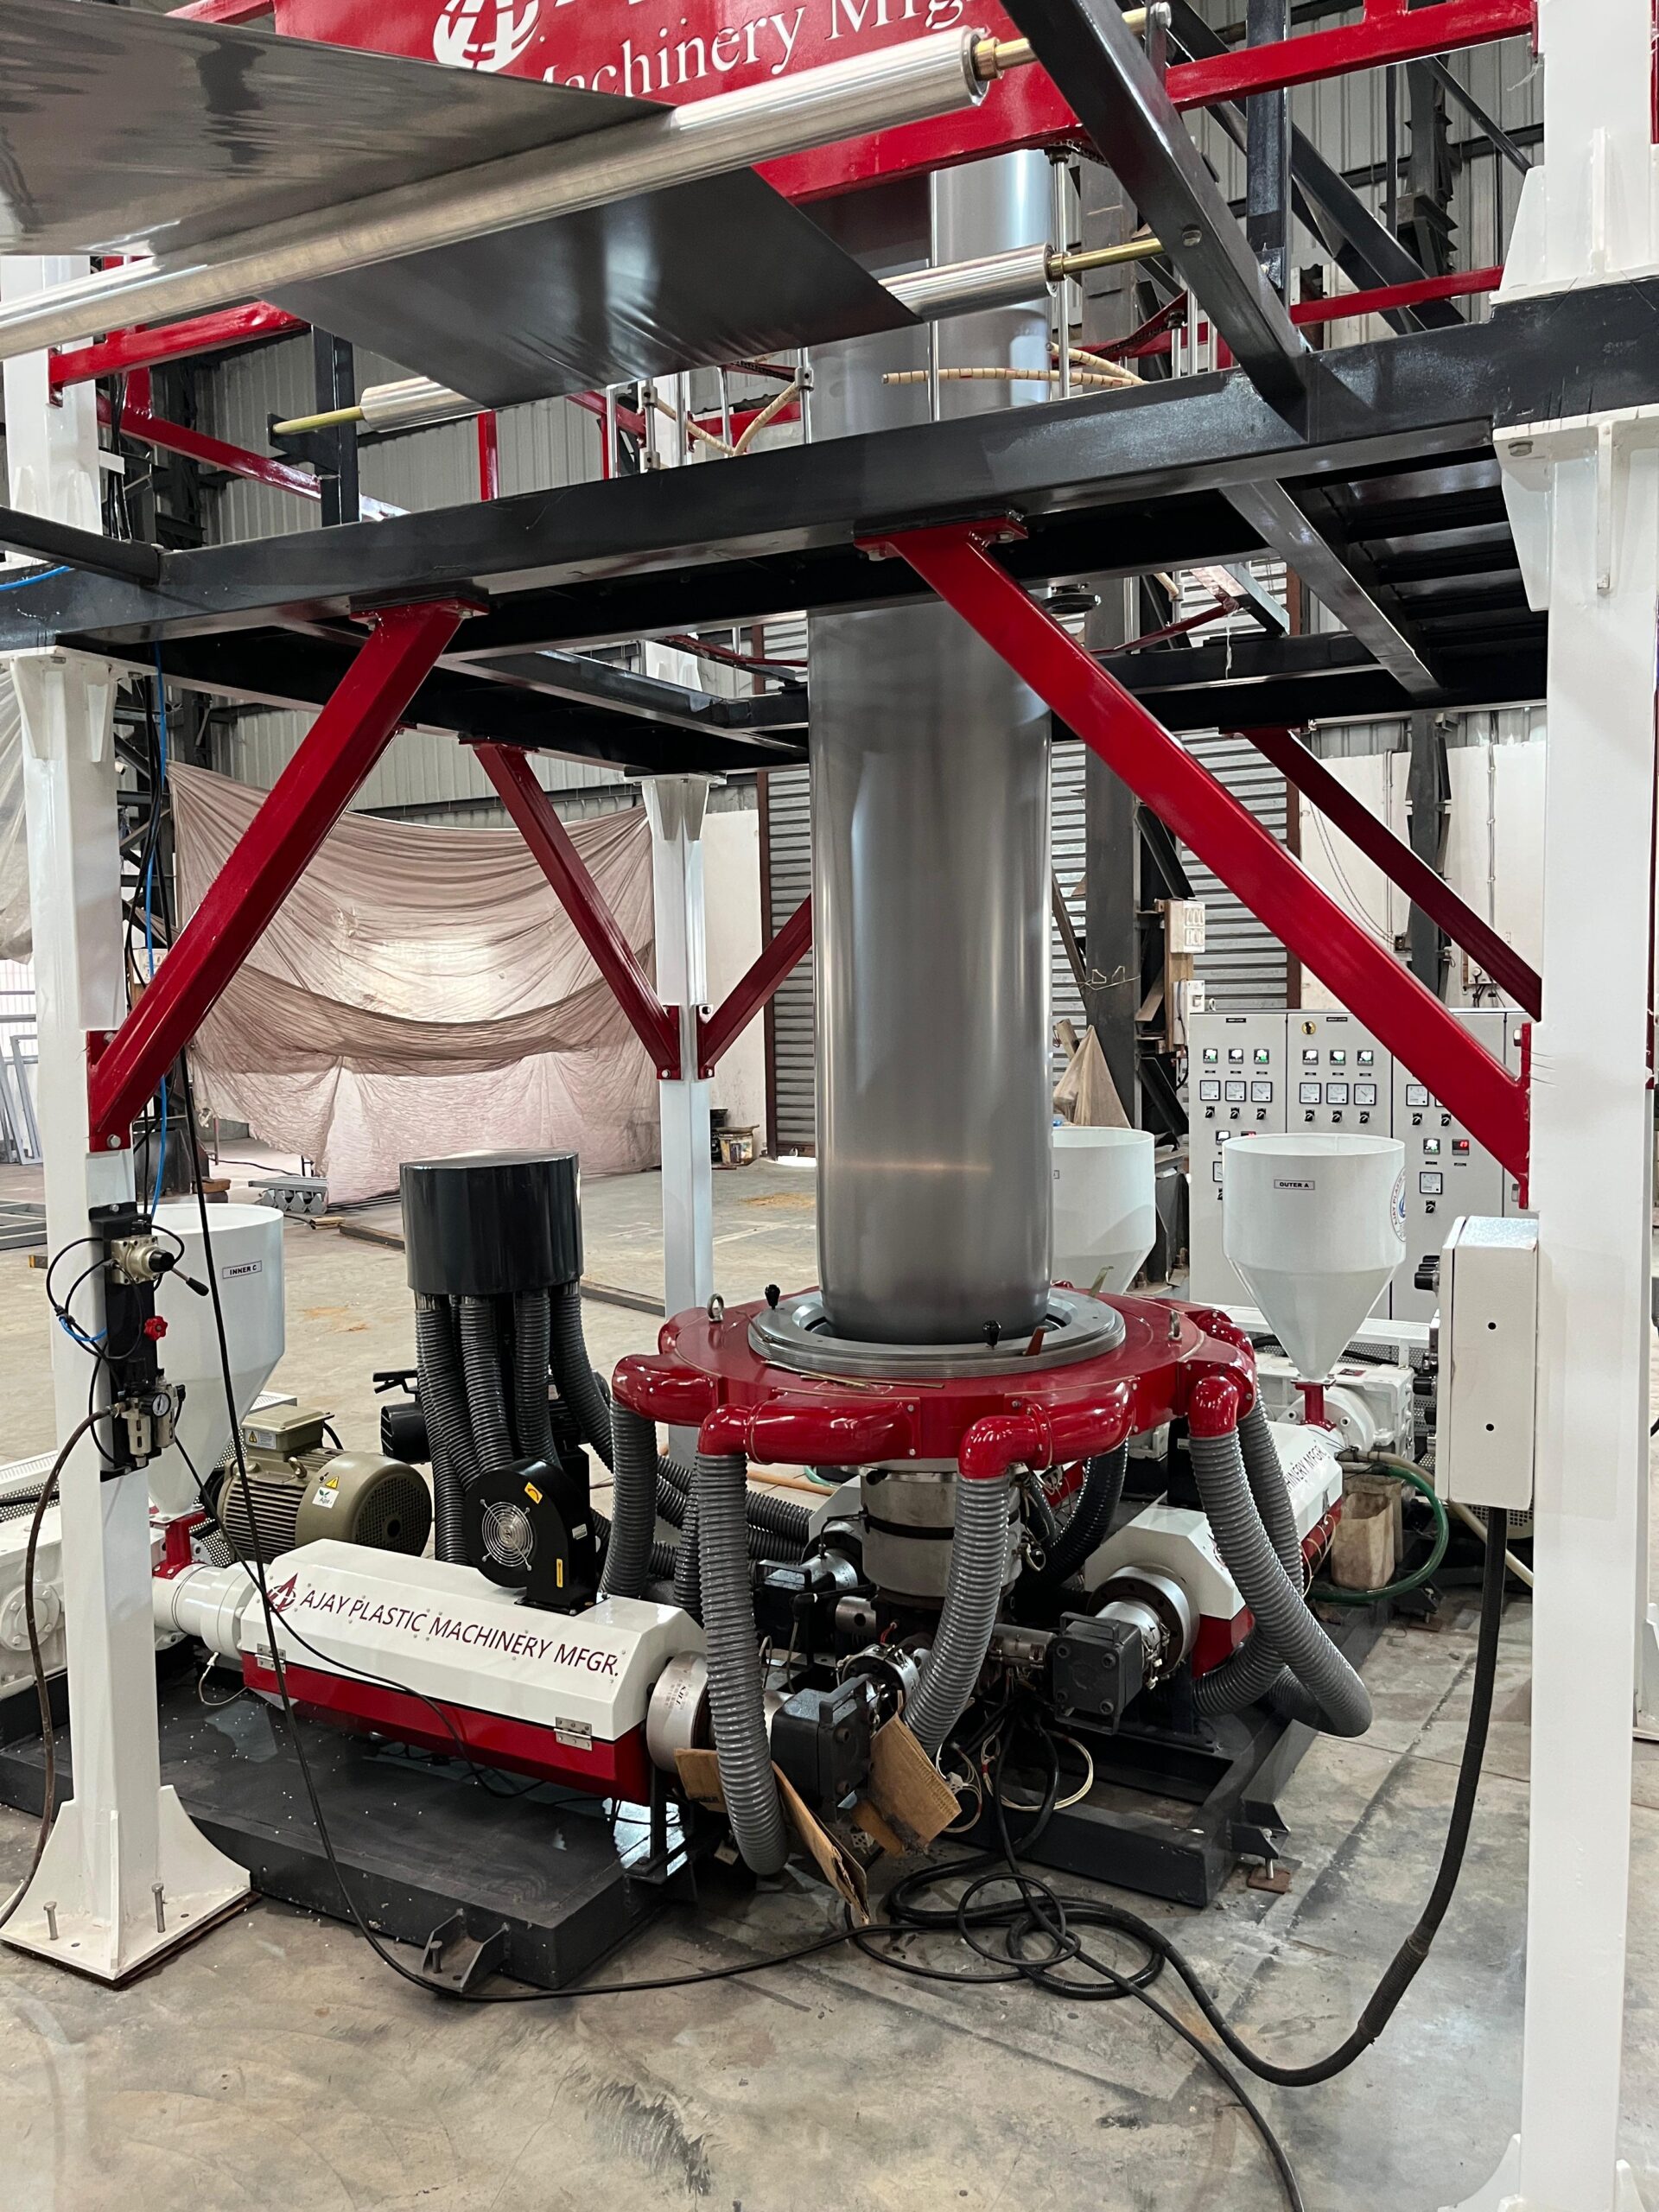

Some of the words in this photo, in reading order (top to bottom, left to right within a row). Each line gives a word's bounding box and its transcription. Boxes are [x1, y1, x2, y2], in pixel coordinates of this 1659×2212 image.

[229, 1265, 251, 1275] INNER
[300, 1589, 351, 1614] AJAY
[347, 1599, 428, 1632] PLASTIC
[428, 1616, 554, 1660] MACHINERY
[553, 1643, 620, 1677] MFGR.
